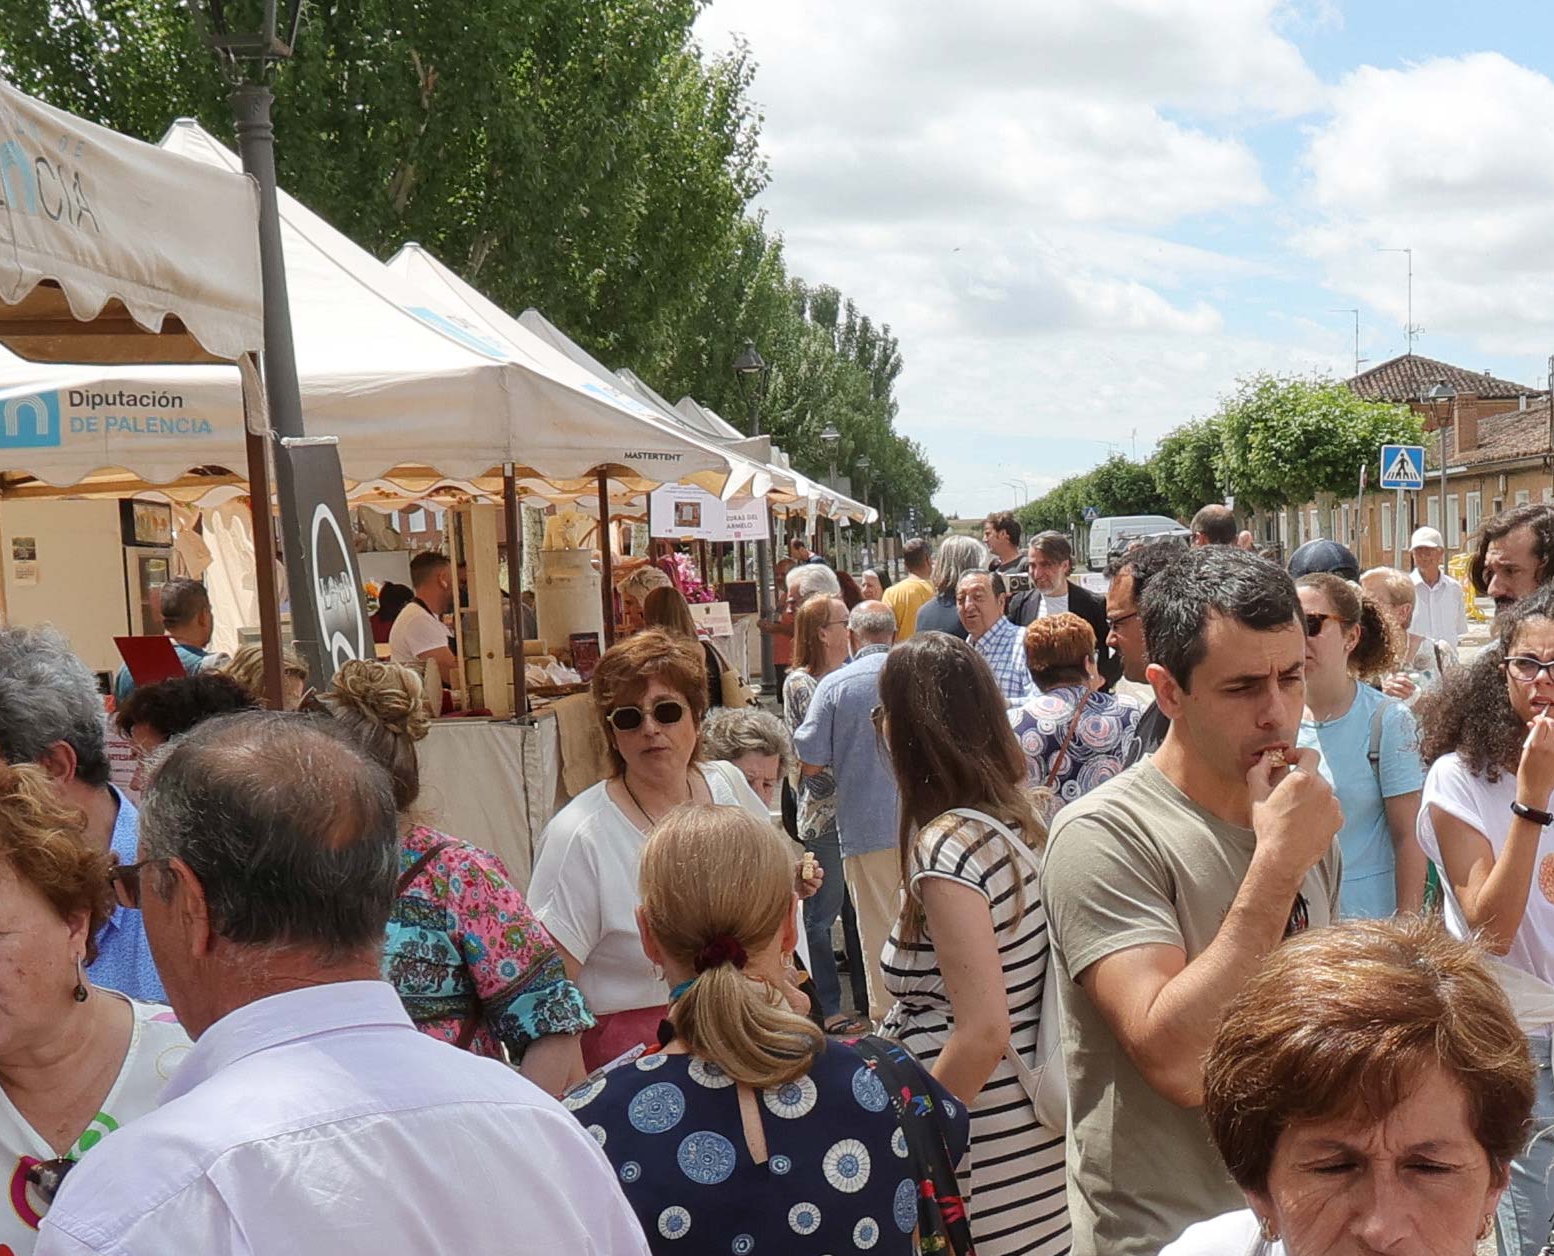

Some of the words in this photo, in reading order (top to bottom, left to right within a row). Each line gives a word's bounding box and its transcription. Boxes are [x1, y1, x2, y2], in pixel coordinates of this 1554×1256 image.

[68, 389, 184, 412] Diputación
[69, 416, 99, 433] DE
[104, 416, 213, 435] PALENCIA
[624, 451, 682, 461] MASTERTENT
